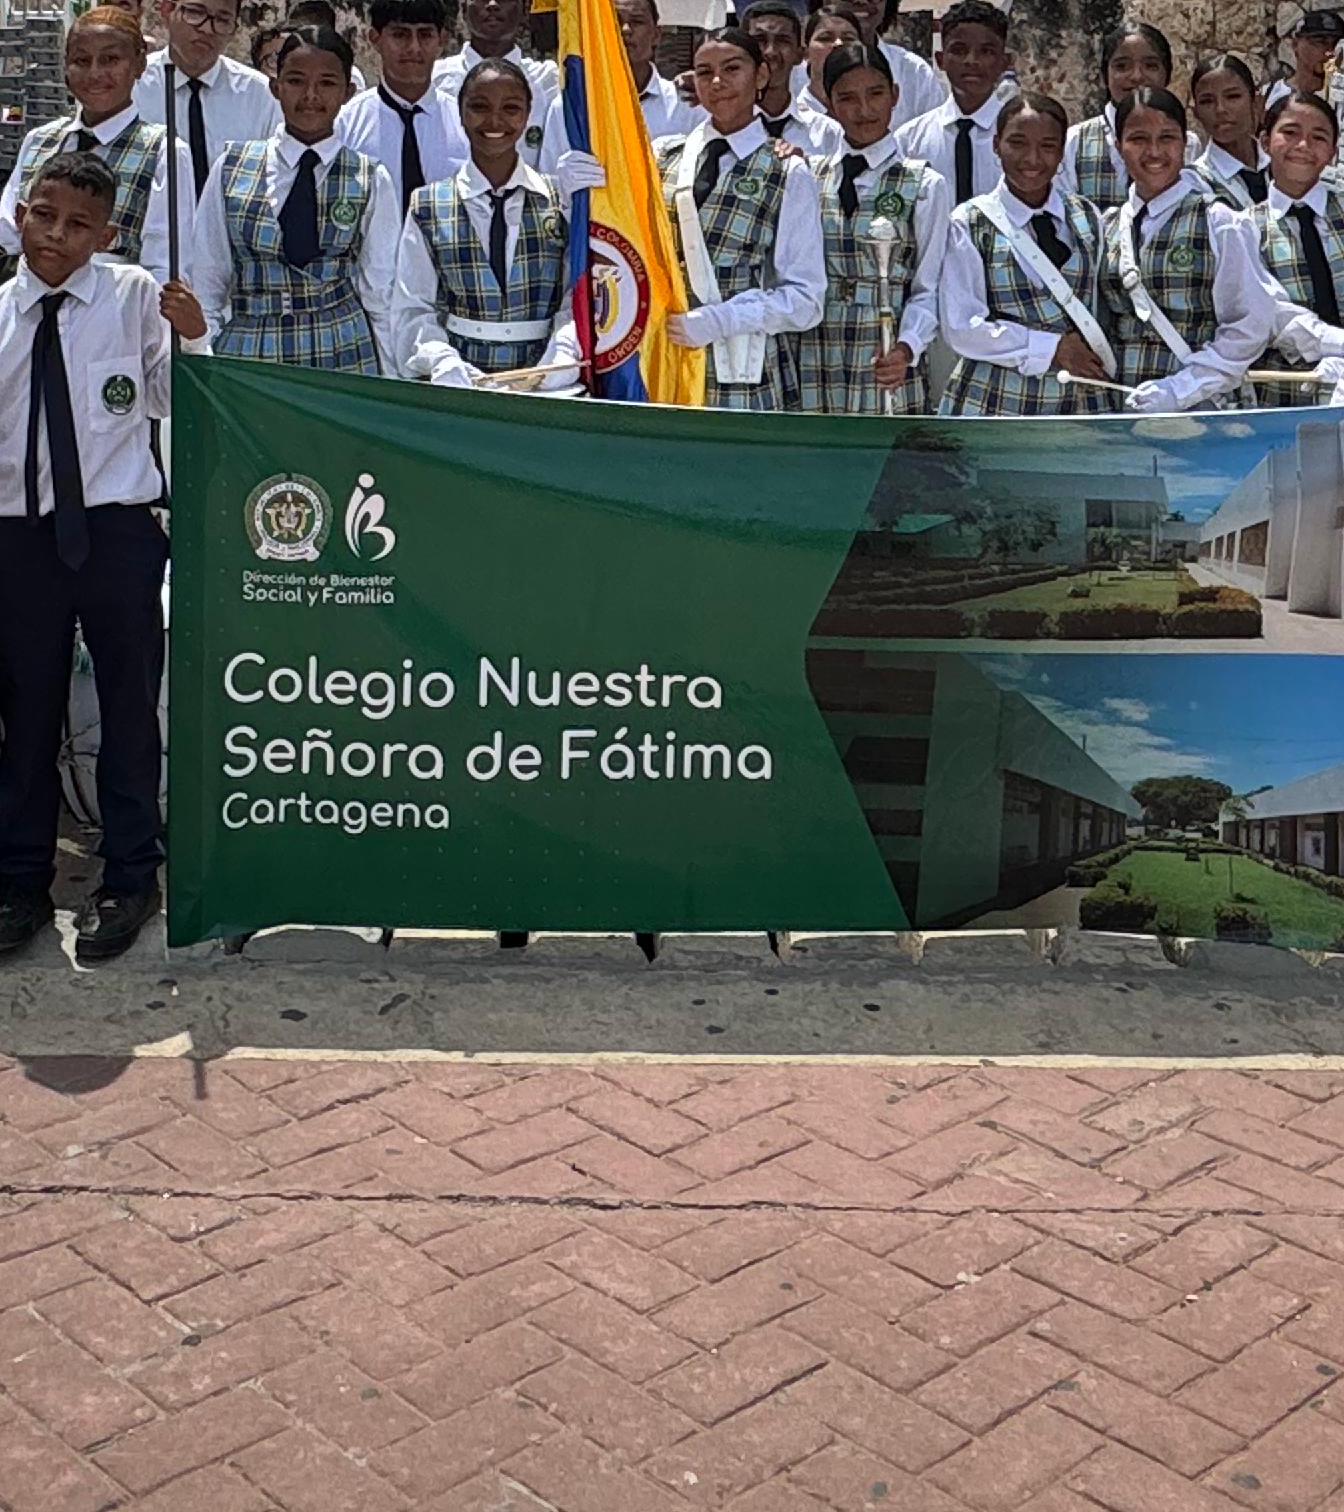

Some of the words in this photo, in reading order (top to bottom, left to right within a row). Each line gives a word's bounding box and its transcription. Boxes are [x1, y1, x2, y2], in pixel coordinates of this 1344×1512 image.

[242, 570, 306, 585] Dirección
[308, 574, 326, 586] de
[330, 574, 395, 587] Bienestar
[242, 583, 302, 602] Social
[307, 590, 318, 607] y
[322, 587, 395, 604] Familia
[223, 652, 455, 720] Colegio
[479, 656, 723, 709] Nuestra
[223, 726, 444, 780] Señora
[466, 730, 542, 781] de
[560, 726, 773, 780] Fátima
[223, 792, 450, 834] Cartagena
